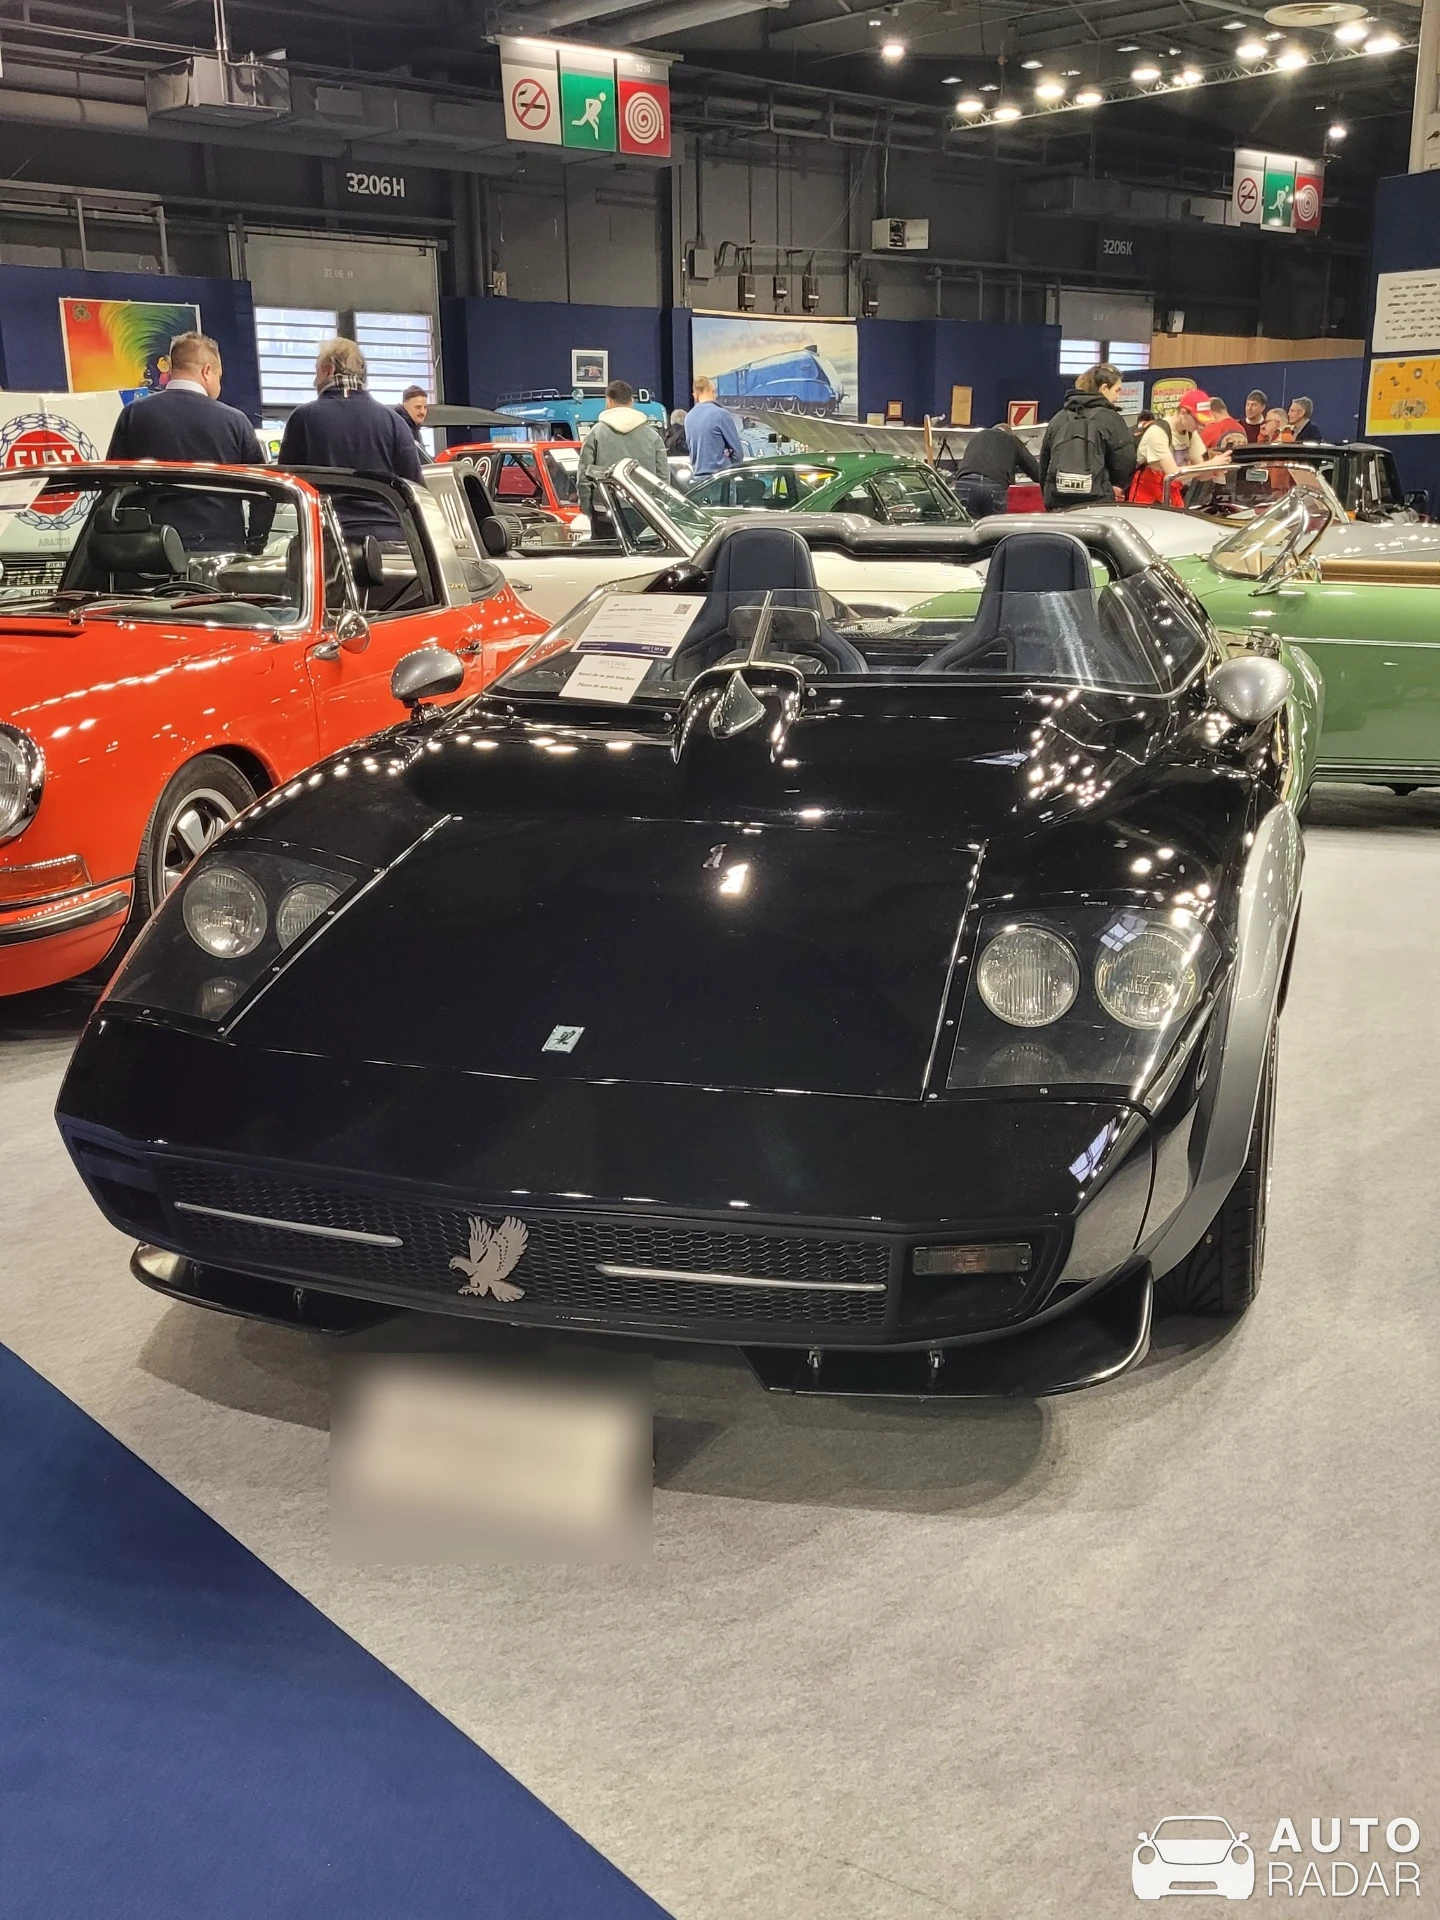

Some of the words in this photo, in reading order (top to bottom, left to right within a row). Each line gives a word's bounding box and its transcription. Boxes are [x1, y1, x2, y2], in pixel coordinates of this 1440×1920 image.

[346, 172, 406, 198] 3206H
[1103, 239, 1134, 256] 3206K
[638, 388, 650, 402] D
